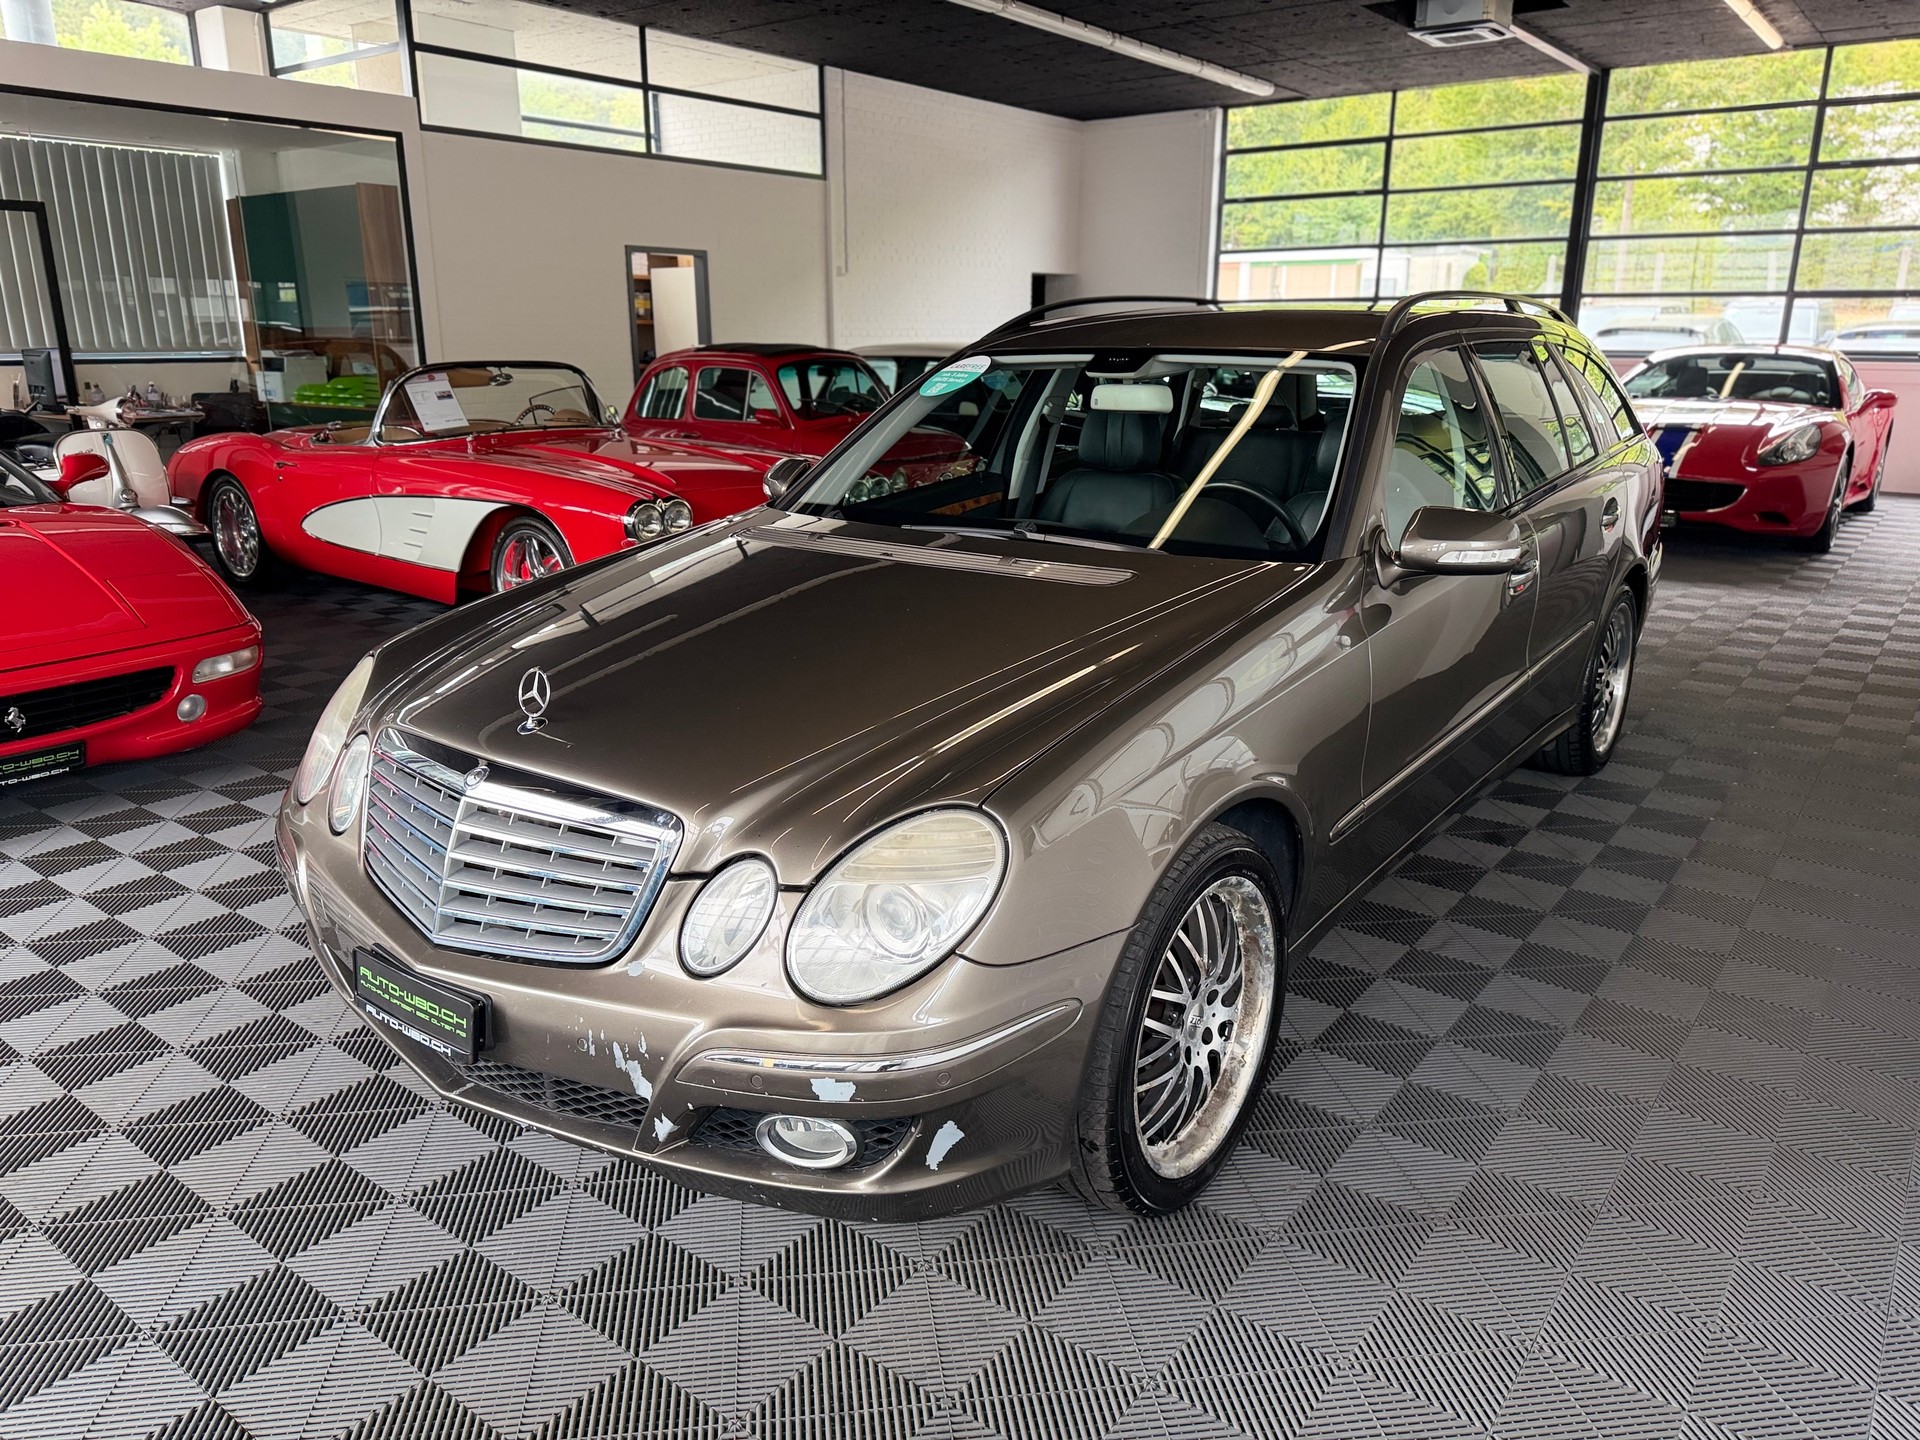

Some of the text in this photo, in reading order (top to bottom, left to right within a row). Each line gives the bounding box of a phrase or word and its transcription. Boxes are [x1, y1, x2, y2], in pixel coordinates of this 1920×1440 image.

[0, 749, 79, 771] O-WBO.CH
[359, 966, 467, 1029] AUTO-WBO.CH
[365, 1004, 452, 1056] AUTO-WBO.CH
